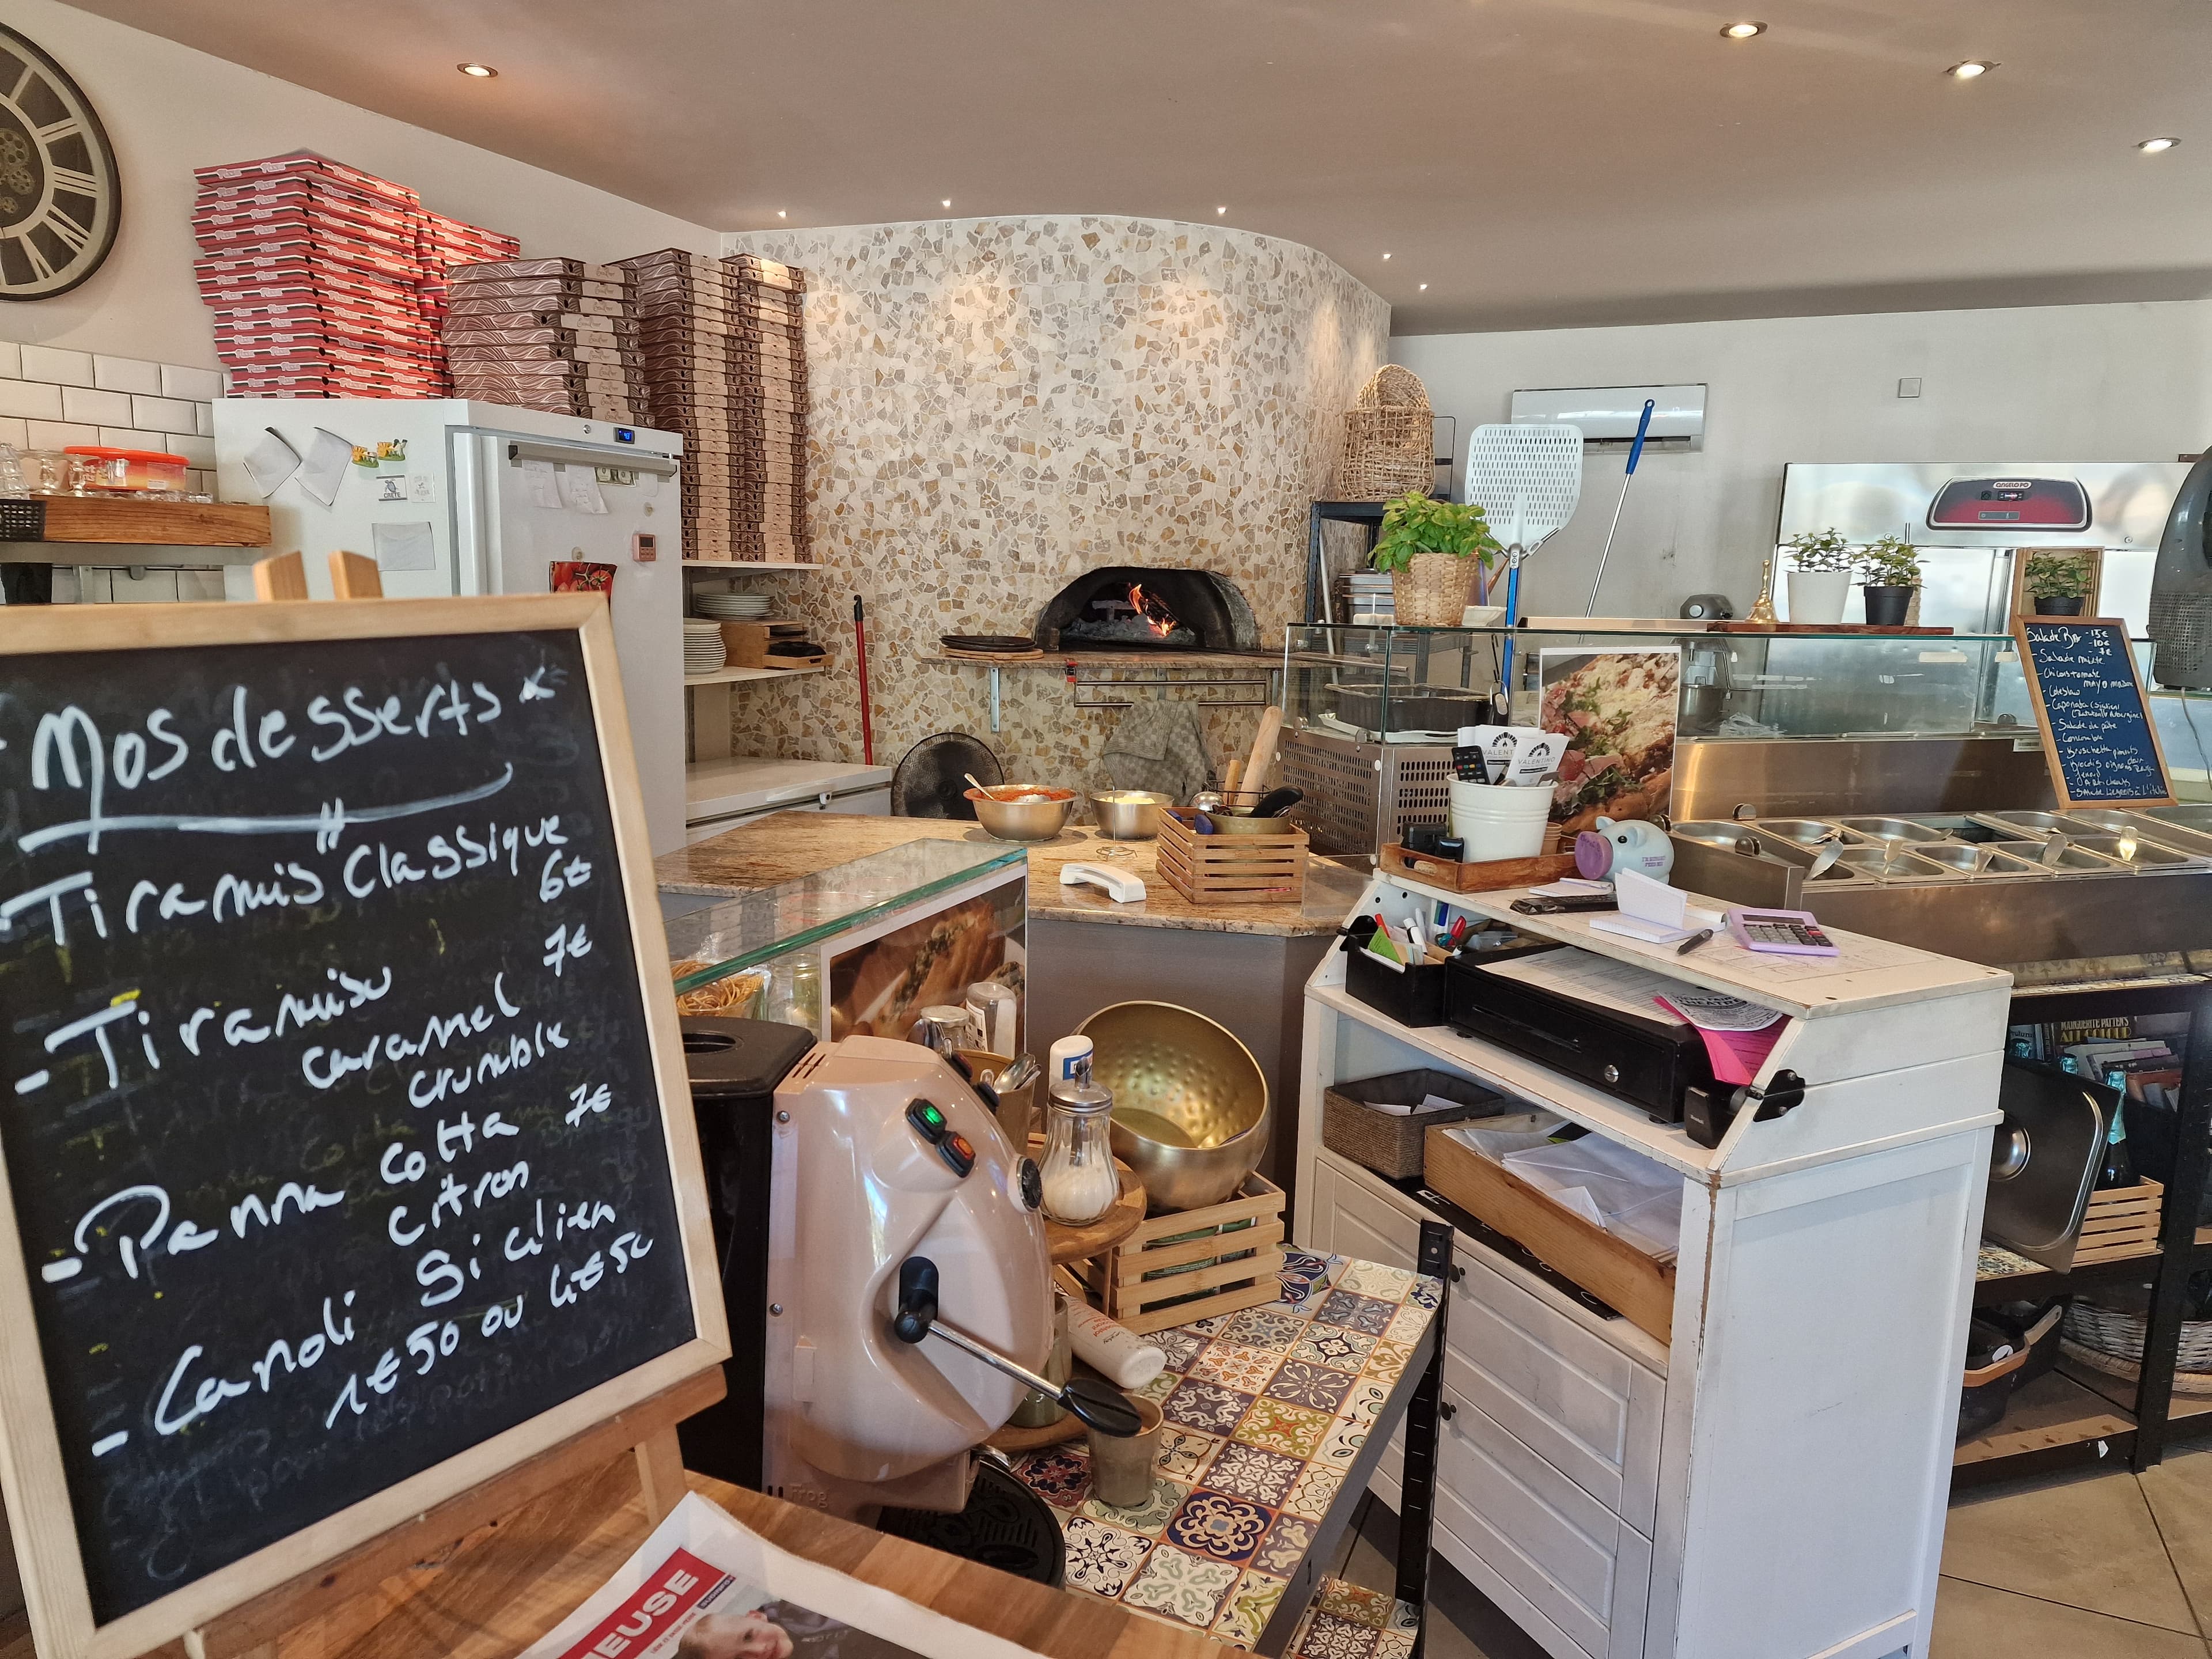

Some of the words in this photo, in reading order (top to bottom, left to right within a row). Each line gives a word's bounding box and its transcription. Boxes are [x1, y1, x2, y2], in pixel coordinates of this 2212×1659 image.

[2027, 627, 2061, 642] Salade
[2039, 648, 2075, 663] Salade
[539, 849, 592, 903] 6€
[543, 923, 593, 978] 7€
[74, 1184, 346, 1279] Panna
[579, 1569, 699, 1659] EUSE
